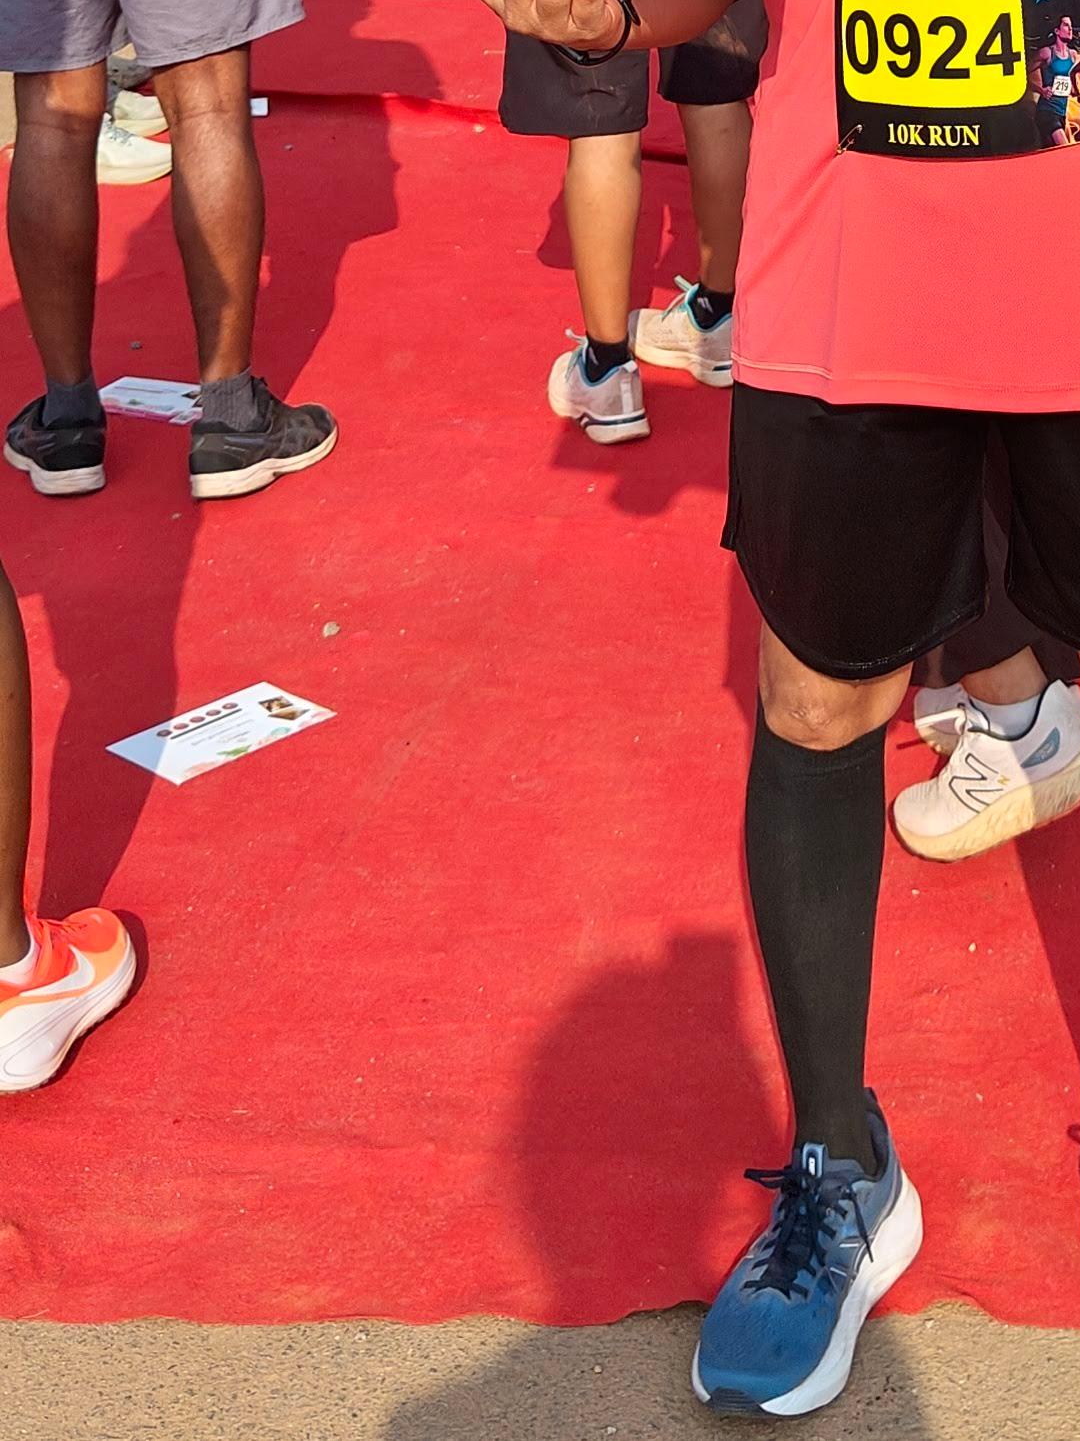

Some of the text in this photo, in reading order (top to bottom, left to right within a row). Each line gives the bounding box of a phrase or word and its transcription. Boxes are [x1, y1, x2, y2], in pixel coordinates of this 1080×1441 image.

[845, 9, 1022, 81] 0924
[1055, 80, 1070, 92] 219
[887, 122, 981, 148] 10K RUN
